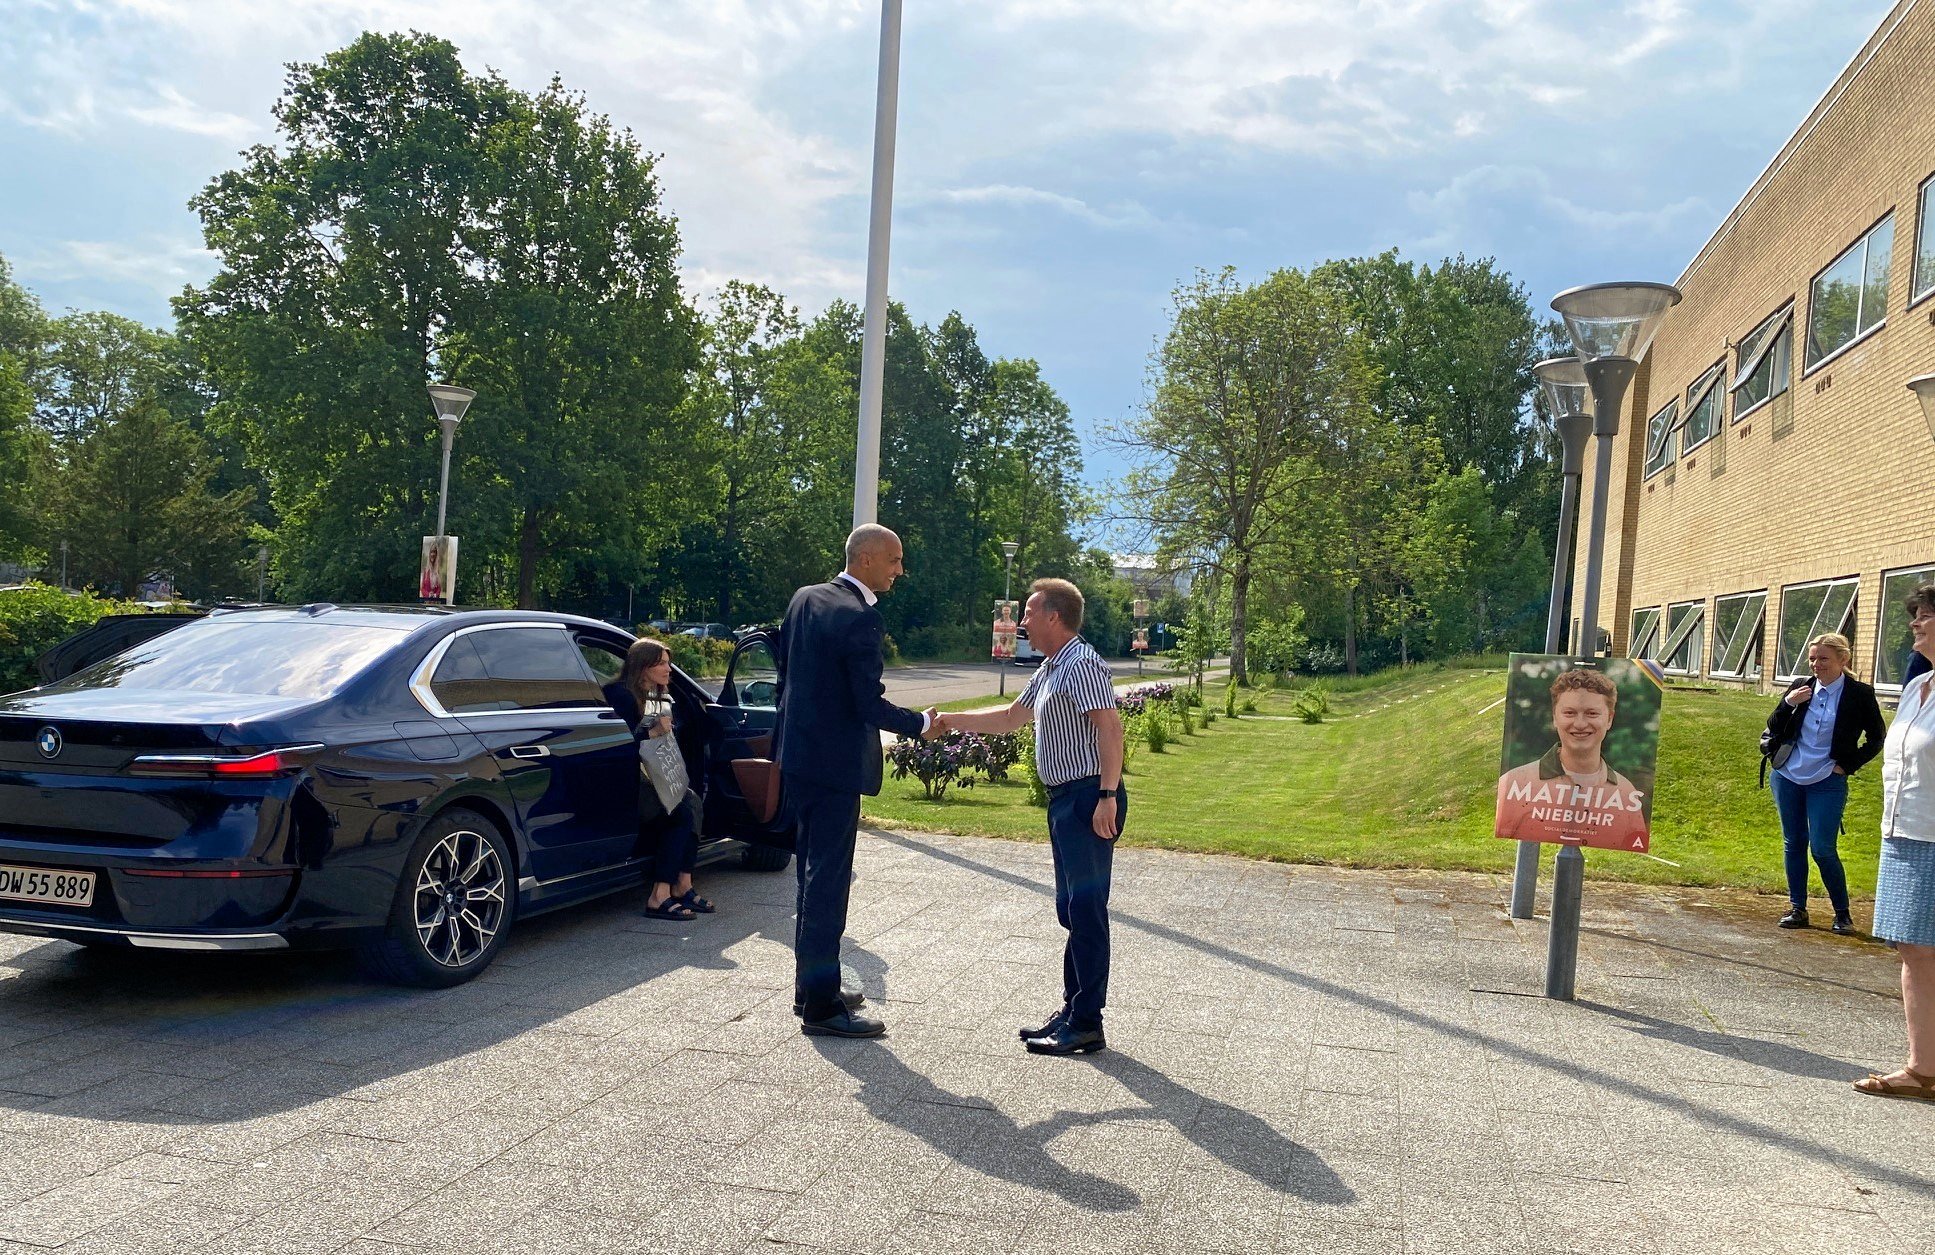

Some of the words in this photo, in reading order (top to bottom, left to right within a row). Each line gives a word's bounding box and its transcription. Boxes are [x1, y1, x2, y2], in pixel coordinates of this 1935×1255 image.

[1507, 780, 1644, 812] MATHIAS
[1531, 806, 1614, 827] NIEBUHR
[1632, 836, 1644, 848] A
[0, 870, 24, 893] DW
[27, 873, 50, 896] 55
[54, 875, 89, 900] 889
